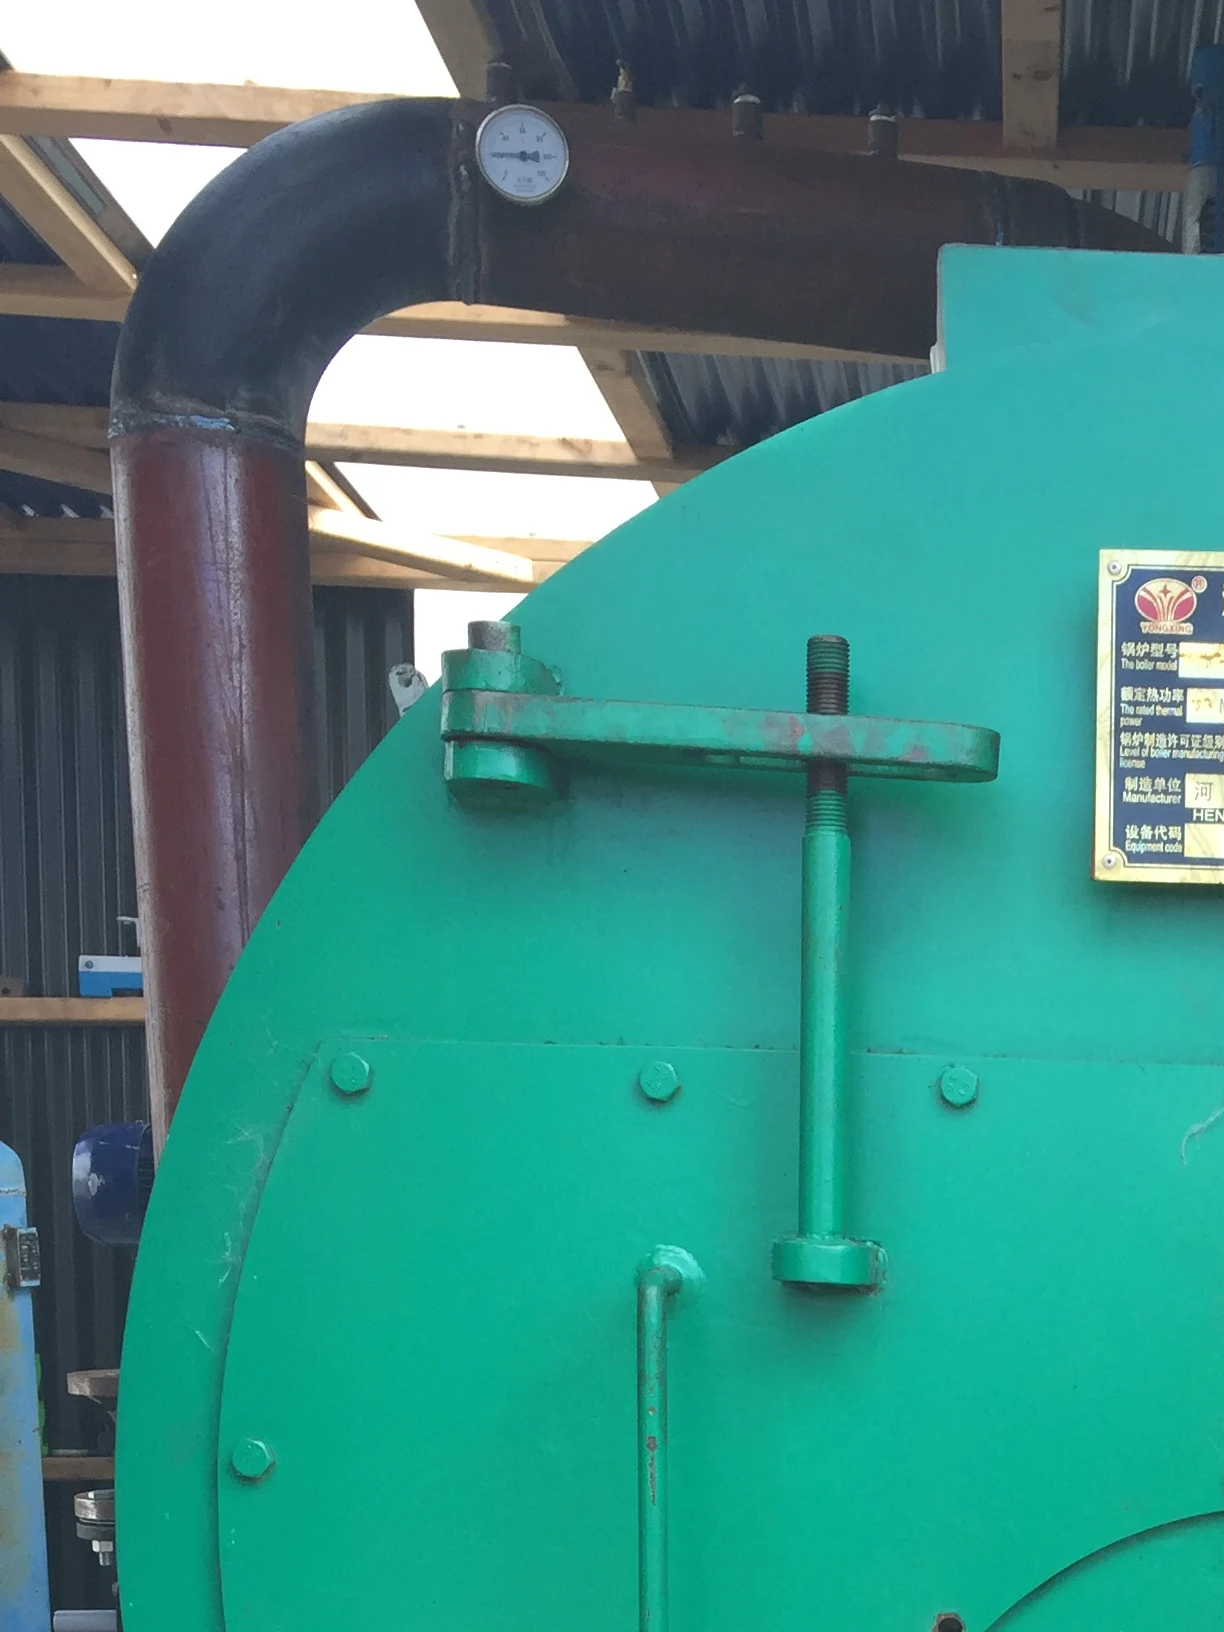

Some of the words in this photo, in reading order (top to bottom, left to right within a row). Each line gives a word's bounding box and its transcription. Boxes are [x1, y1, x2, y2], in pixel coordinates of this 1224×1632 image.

[1141, 624, 1192, 634] YONGXING
[1121, 642, 1179, 658] 锅炉型号
[1121, 658, 1134, 669] The
[1136, 659, 1154, 670] boiler
[1156, 660, 1177, 671] model
[1120, 686, 1184, 703] 额定热功率
[1120, 704, 1134, 715] The
[1156, 705, 1183, 716] thermal
[1120, 717, 1142, 727] power
[1120, 747, 1140, 757] Level
[1141, 747, 1149, 758] of
[1172, 749, 1224, 762] manufacturing
[1125, 776, 1181, 793] 制造单位
[1123, 791, 1181, 804] Manufacturer
[1126, 825, 1181, 841] 设备代码
[1125, 840, 1163, 854] Equipment
[1165, 841, 1183, 852] code
